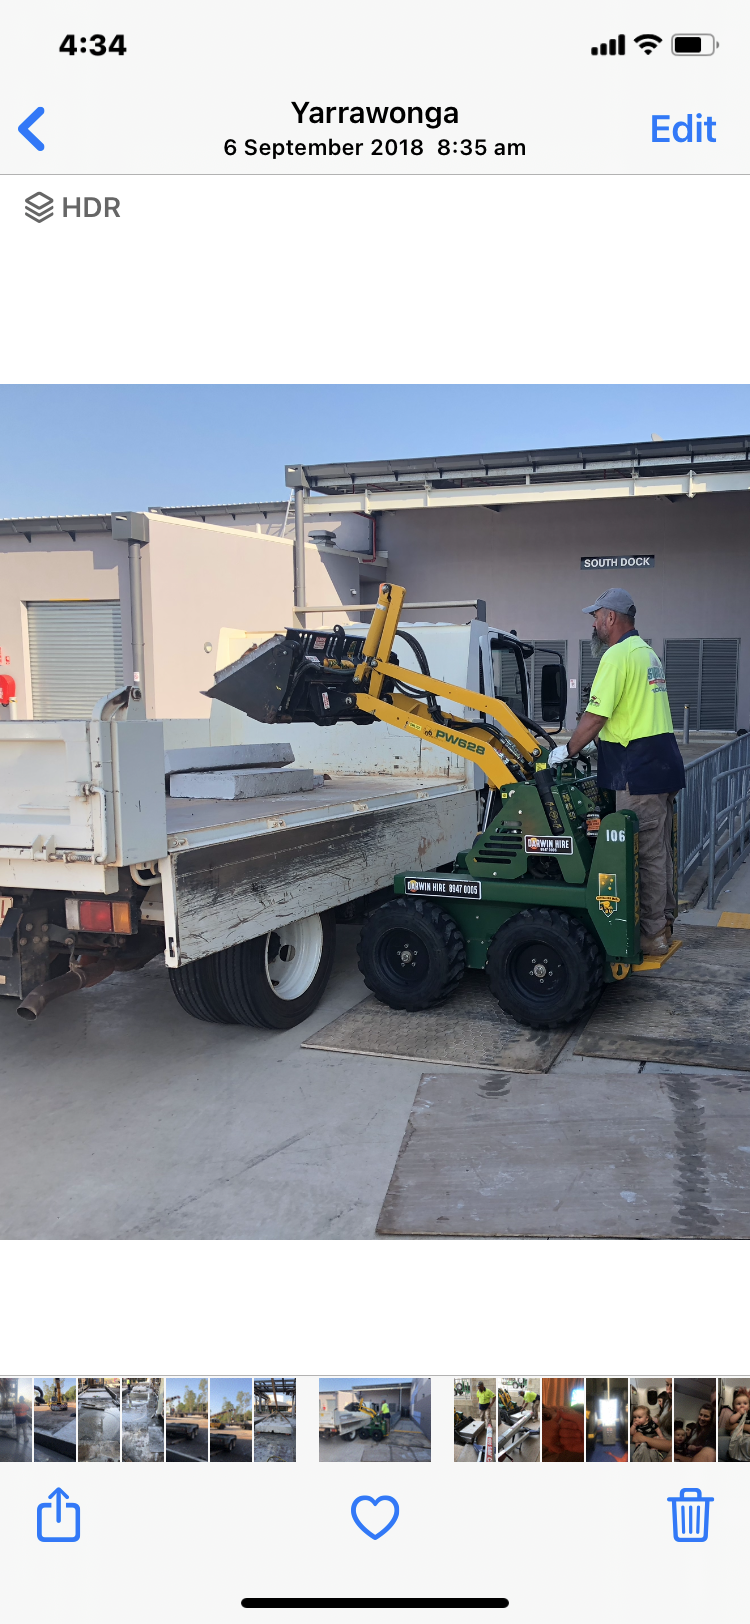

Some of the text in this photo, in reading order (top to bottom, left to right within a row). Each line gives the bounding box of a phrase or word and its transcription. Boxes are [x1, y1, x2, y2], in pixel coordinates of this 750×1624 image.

[59, 34, 127, 56] 4:34
[291, 102, 459, 129] Yarrawonga
[652, 113, 717, 142] Edit
[224, 138, 526, 160] 6 September 2018 8:35 am
[63, 197, 121, 217] HDR
[584, 557, 650, 568] SOUTH DOCK
[436, 729, 486, 756] PW628
[527, 838, 570, 849] DARWIN HIRE
[606, 829, 626, 842] 106
[407, 881, 431, 891] DARWIN
[432, 882, 446, 892] HIRE
